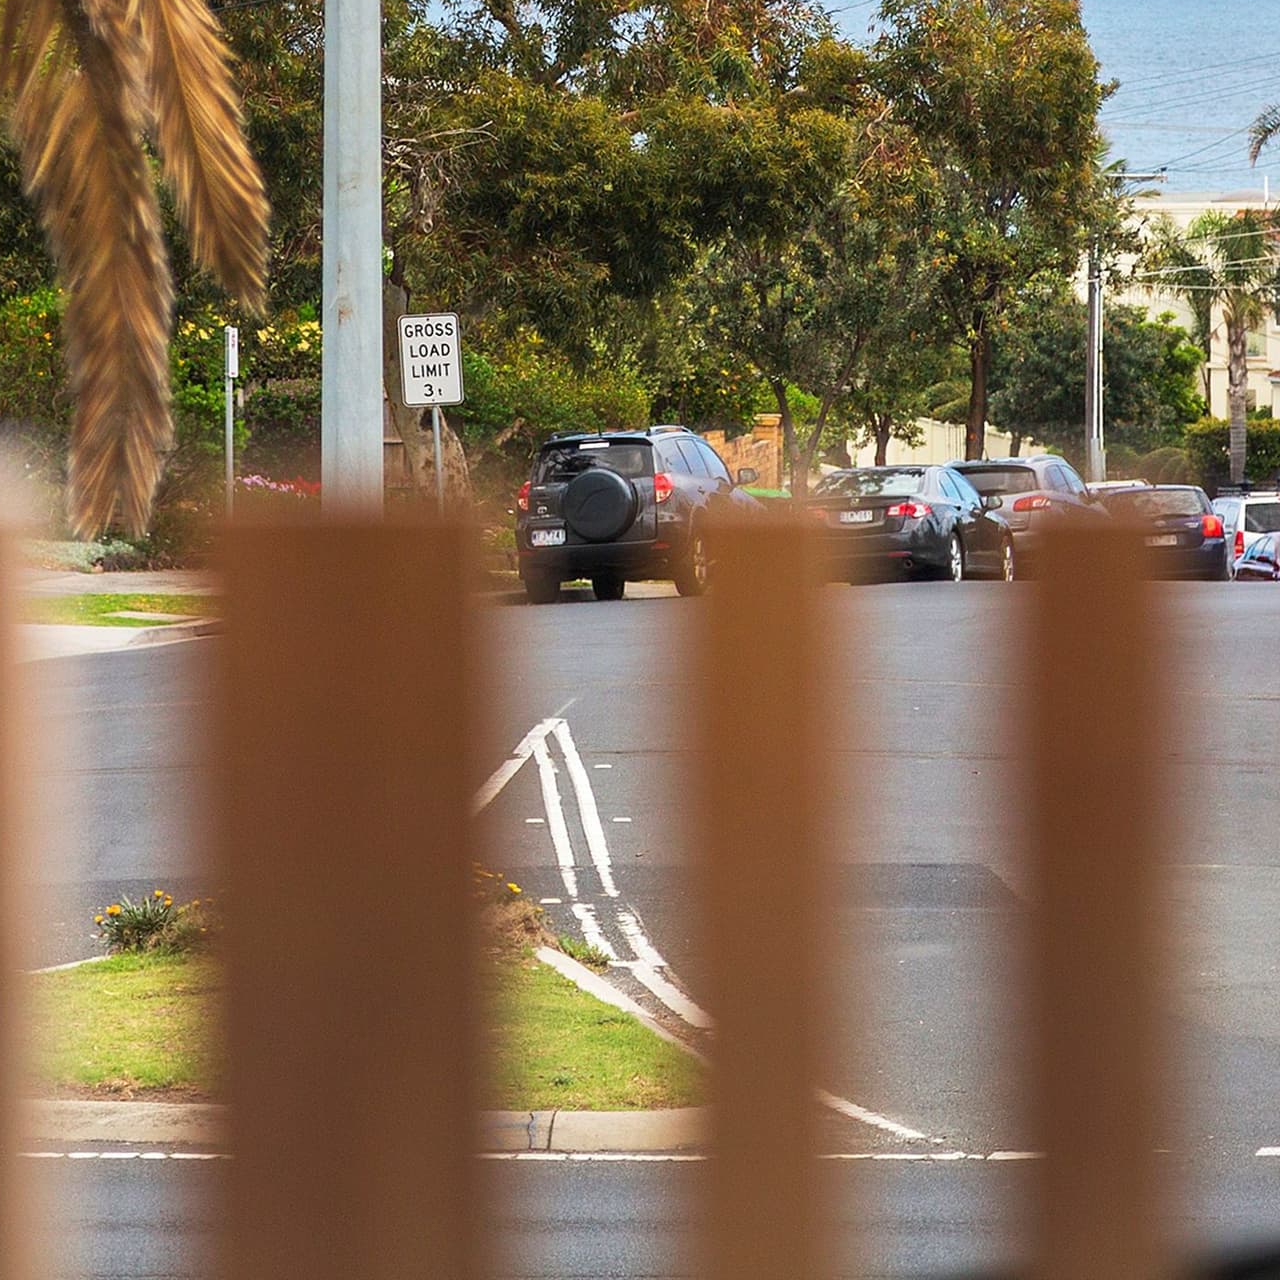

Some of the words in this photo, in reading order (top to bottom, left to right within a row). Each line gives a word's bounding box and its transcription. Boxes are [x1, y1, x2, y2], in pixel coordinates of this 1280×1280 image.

[404, 322, 454, 338] GROSS
[410, 343, 450, 358] LOAD
[412, 363, 450, 378] LIMIT
